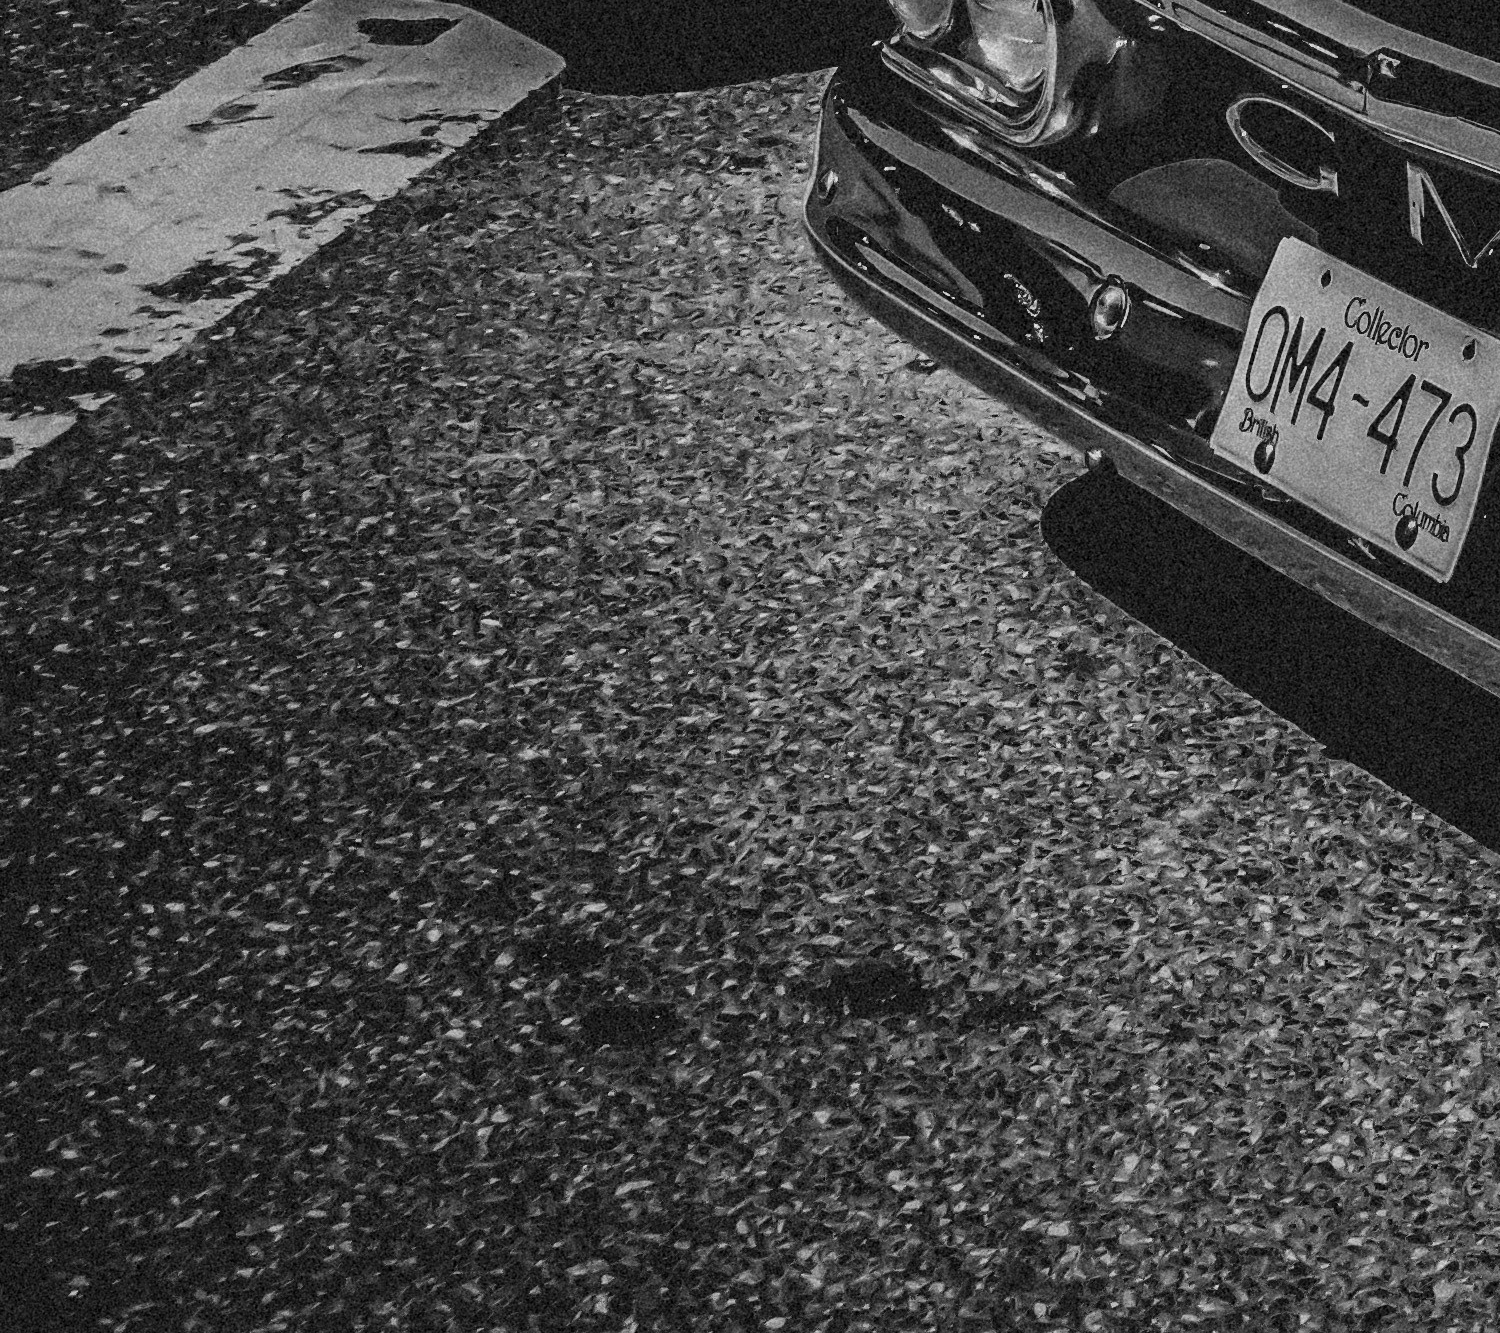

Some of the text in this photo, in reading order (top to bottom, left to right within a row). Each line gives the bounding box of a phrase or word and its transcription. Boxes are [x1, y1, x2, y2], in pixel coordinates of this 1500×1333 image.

[1343, 295, 1430, 362] Collector
[1238, 407, 1450, 544] British Columbia
